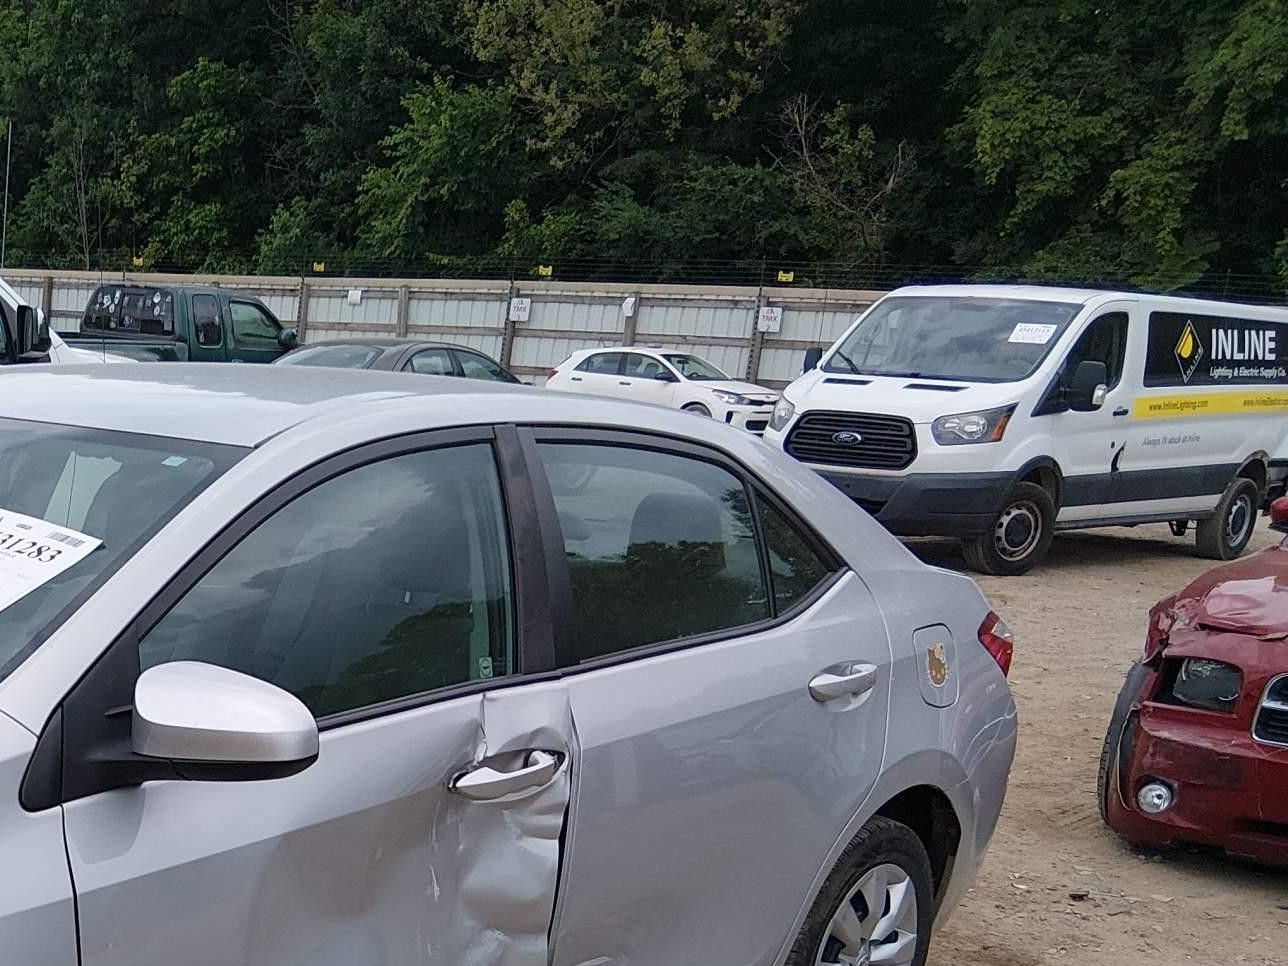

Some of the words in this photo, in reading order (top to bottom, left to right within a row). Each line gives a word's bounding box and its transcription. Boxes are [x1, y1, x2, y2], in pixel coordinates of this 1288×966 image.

[1211, 328, 1276, 361] INLINE
[1209, 366, 1233, 379] Lighting
[1233, 366, 1238, 376] &
[1239, 365, 1259, 377] Electric
[1259, 366, 1278, 379] Supply
